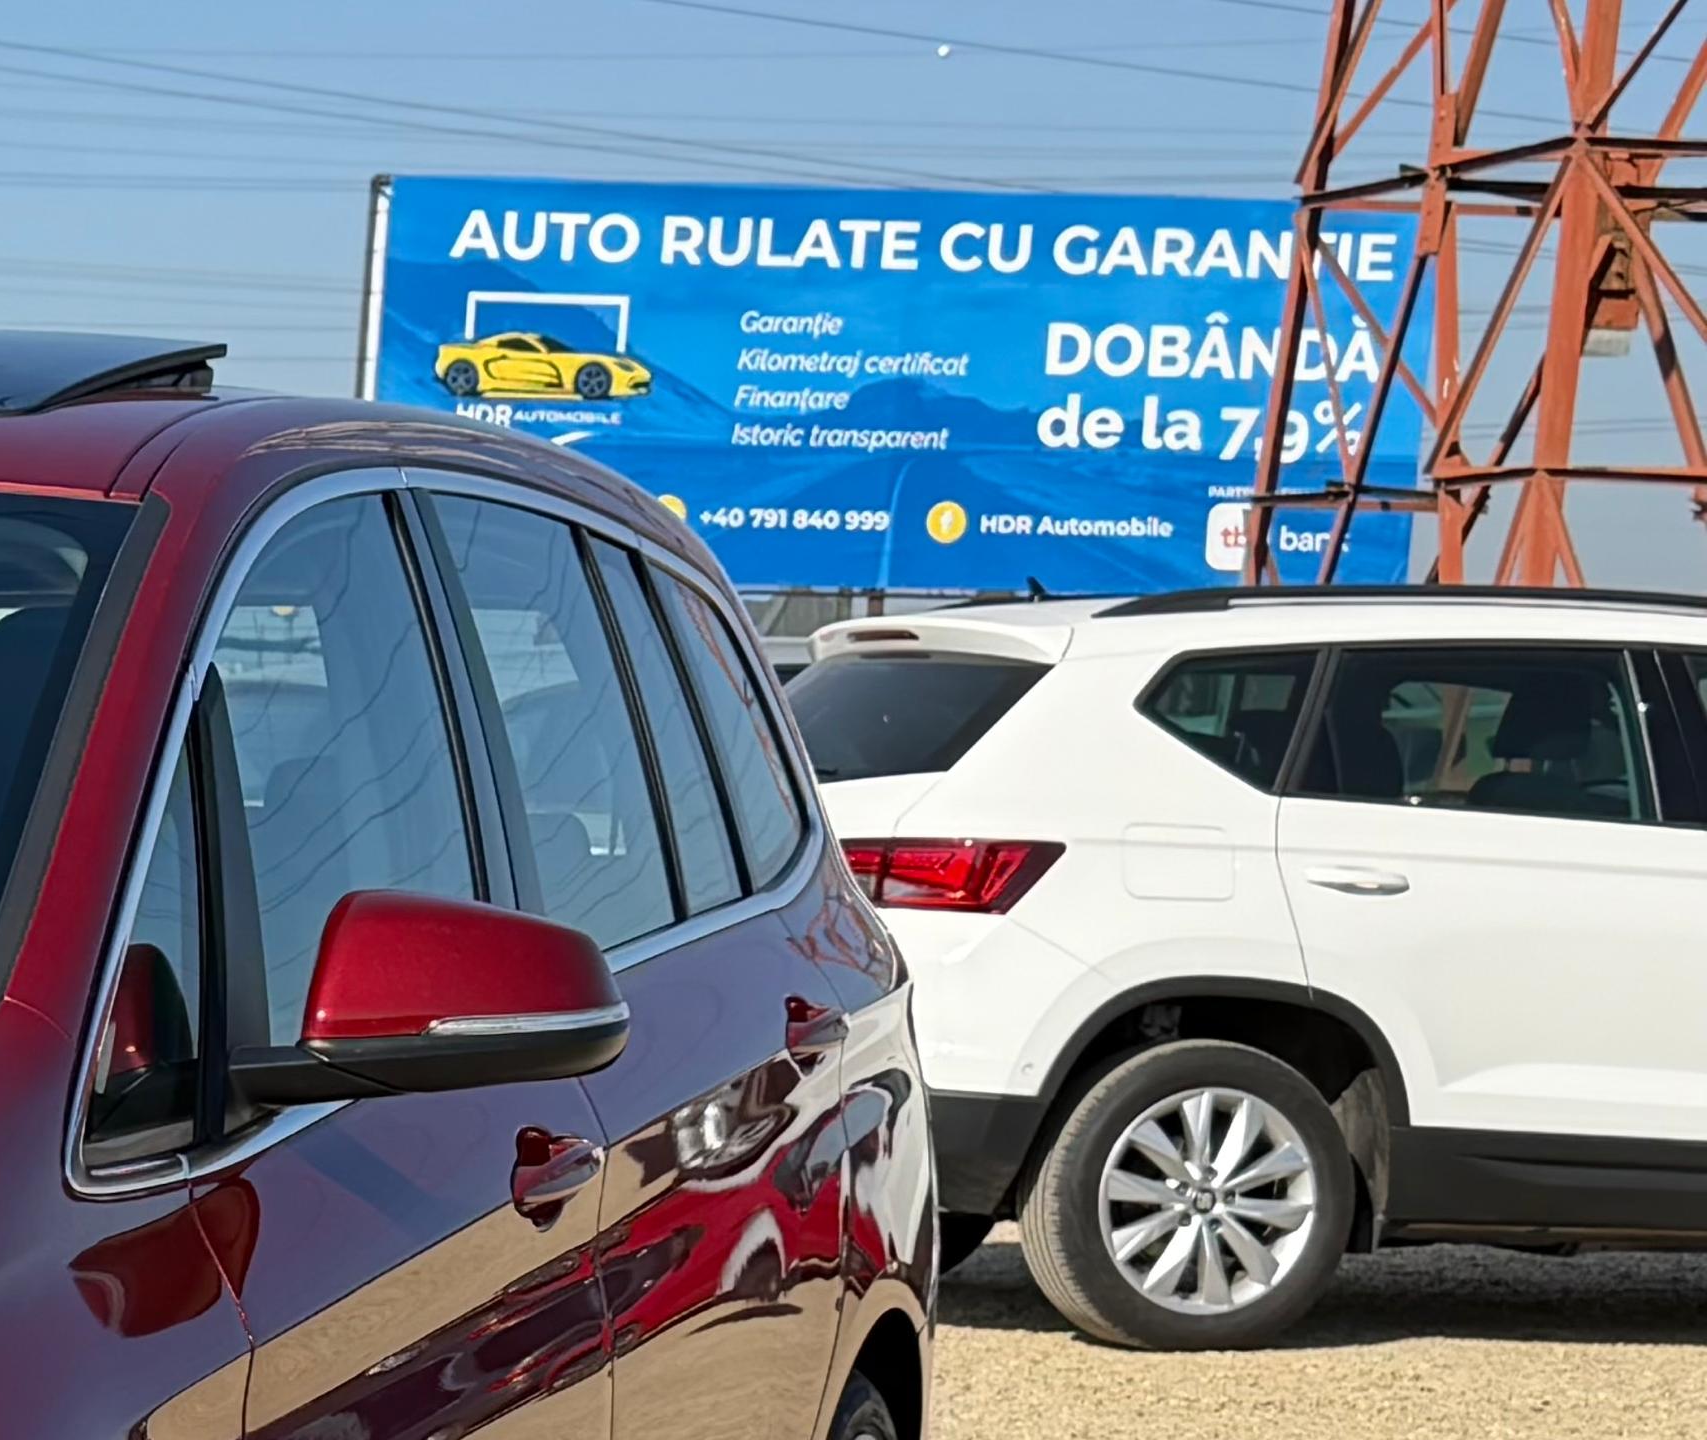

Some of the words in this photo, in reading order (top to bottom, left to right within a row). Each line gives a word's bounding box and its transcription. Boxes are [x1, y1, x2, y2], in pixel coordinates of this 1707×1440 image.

[449, 209, 640, 263] AUTO
[660, 215, 921, 270] RULATE
[939, 221, 1033, 274] CU
[737, 348, 862, 378] Kilometraj
[864, 352, 969, 376] certificat
[456, 402, 513, 428] HDR
[514, 410, 622, 425] AUTOMOBILE
[1037, 393, 1125, 448] de
[1141, 395, 1202, 451] la
[731, 422, 804, 447] Istoric
[809, 424, 949, 453] transparent
[699, 508, 744, 528] +40
[750, 508, 787, 529] 791
[792, 509, 839, 530] 840
[845, 510, 890, 531] 999
[980, 514, 1032, 535] HDR
[1037, 515, 1174, 538] Automobile
